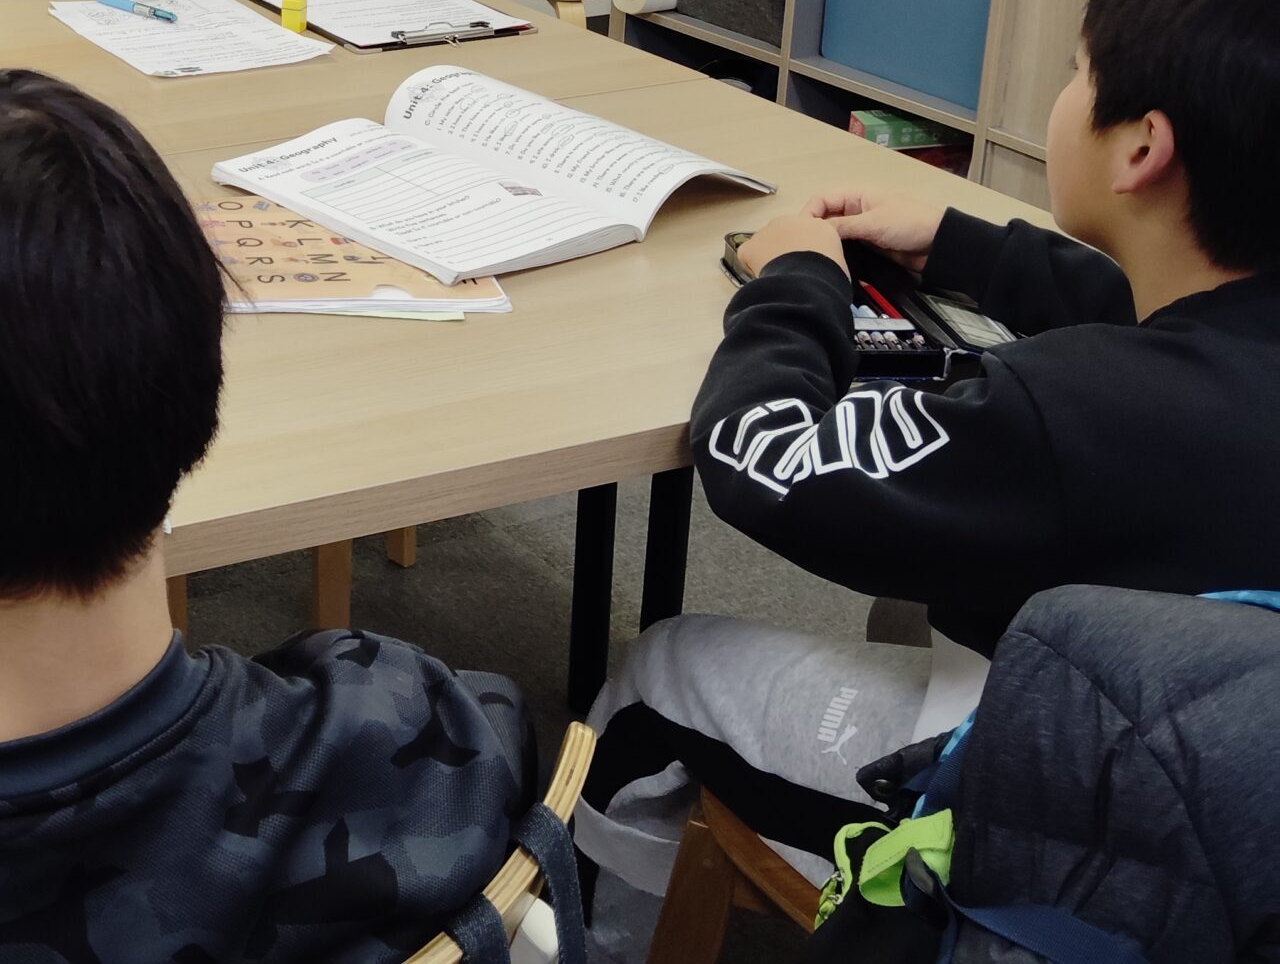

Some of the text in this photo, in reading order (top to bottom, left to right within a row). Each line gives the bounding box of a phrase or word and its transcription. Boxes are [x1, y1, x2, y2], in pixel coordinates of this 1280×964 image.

[403, 94, 422, 119] Unit
[237, 163, 265, 173] Unit
[280, 137, 338, 160] Geography
[226, 219, 254, 229] P
[285, 219, 315, 229] K
[236, 237, 264, 248] Q
[296, 238, 323, 246] L
[245, 256, 274, 266] R
[305, 253, 339, 265] M
[256, 274, 286, 284] S
[319, 272, 352, 283] N
[817, 685, 859, 744] PUMA
